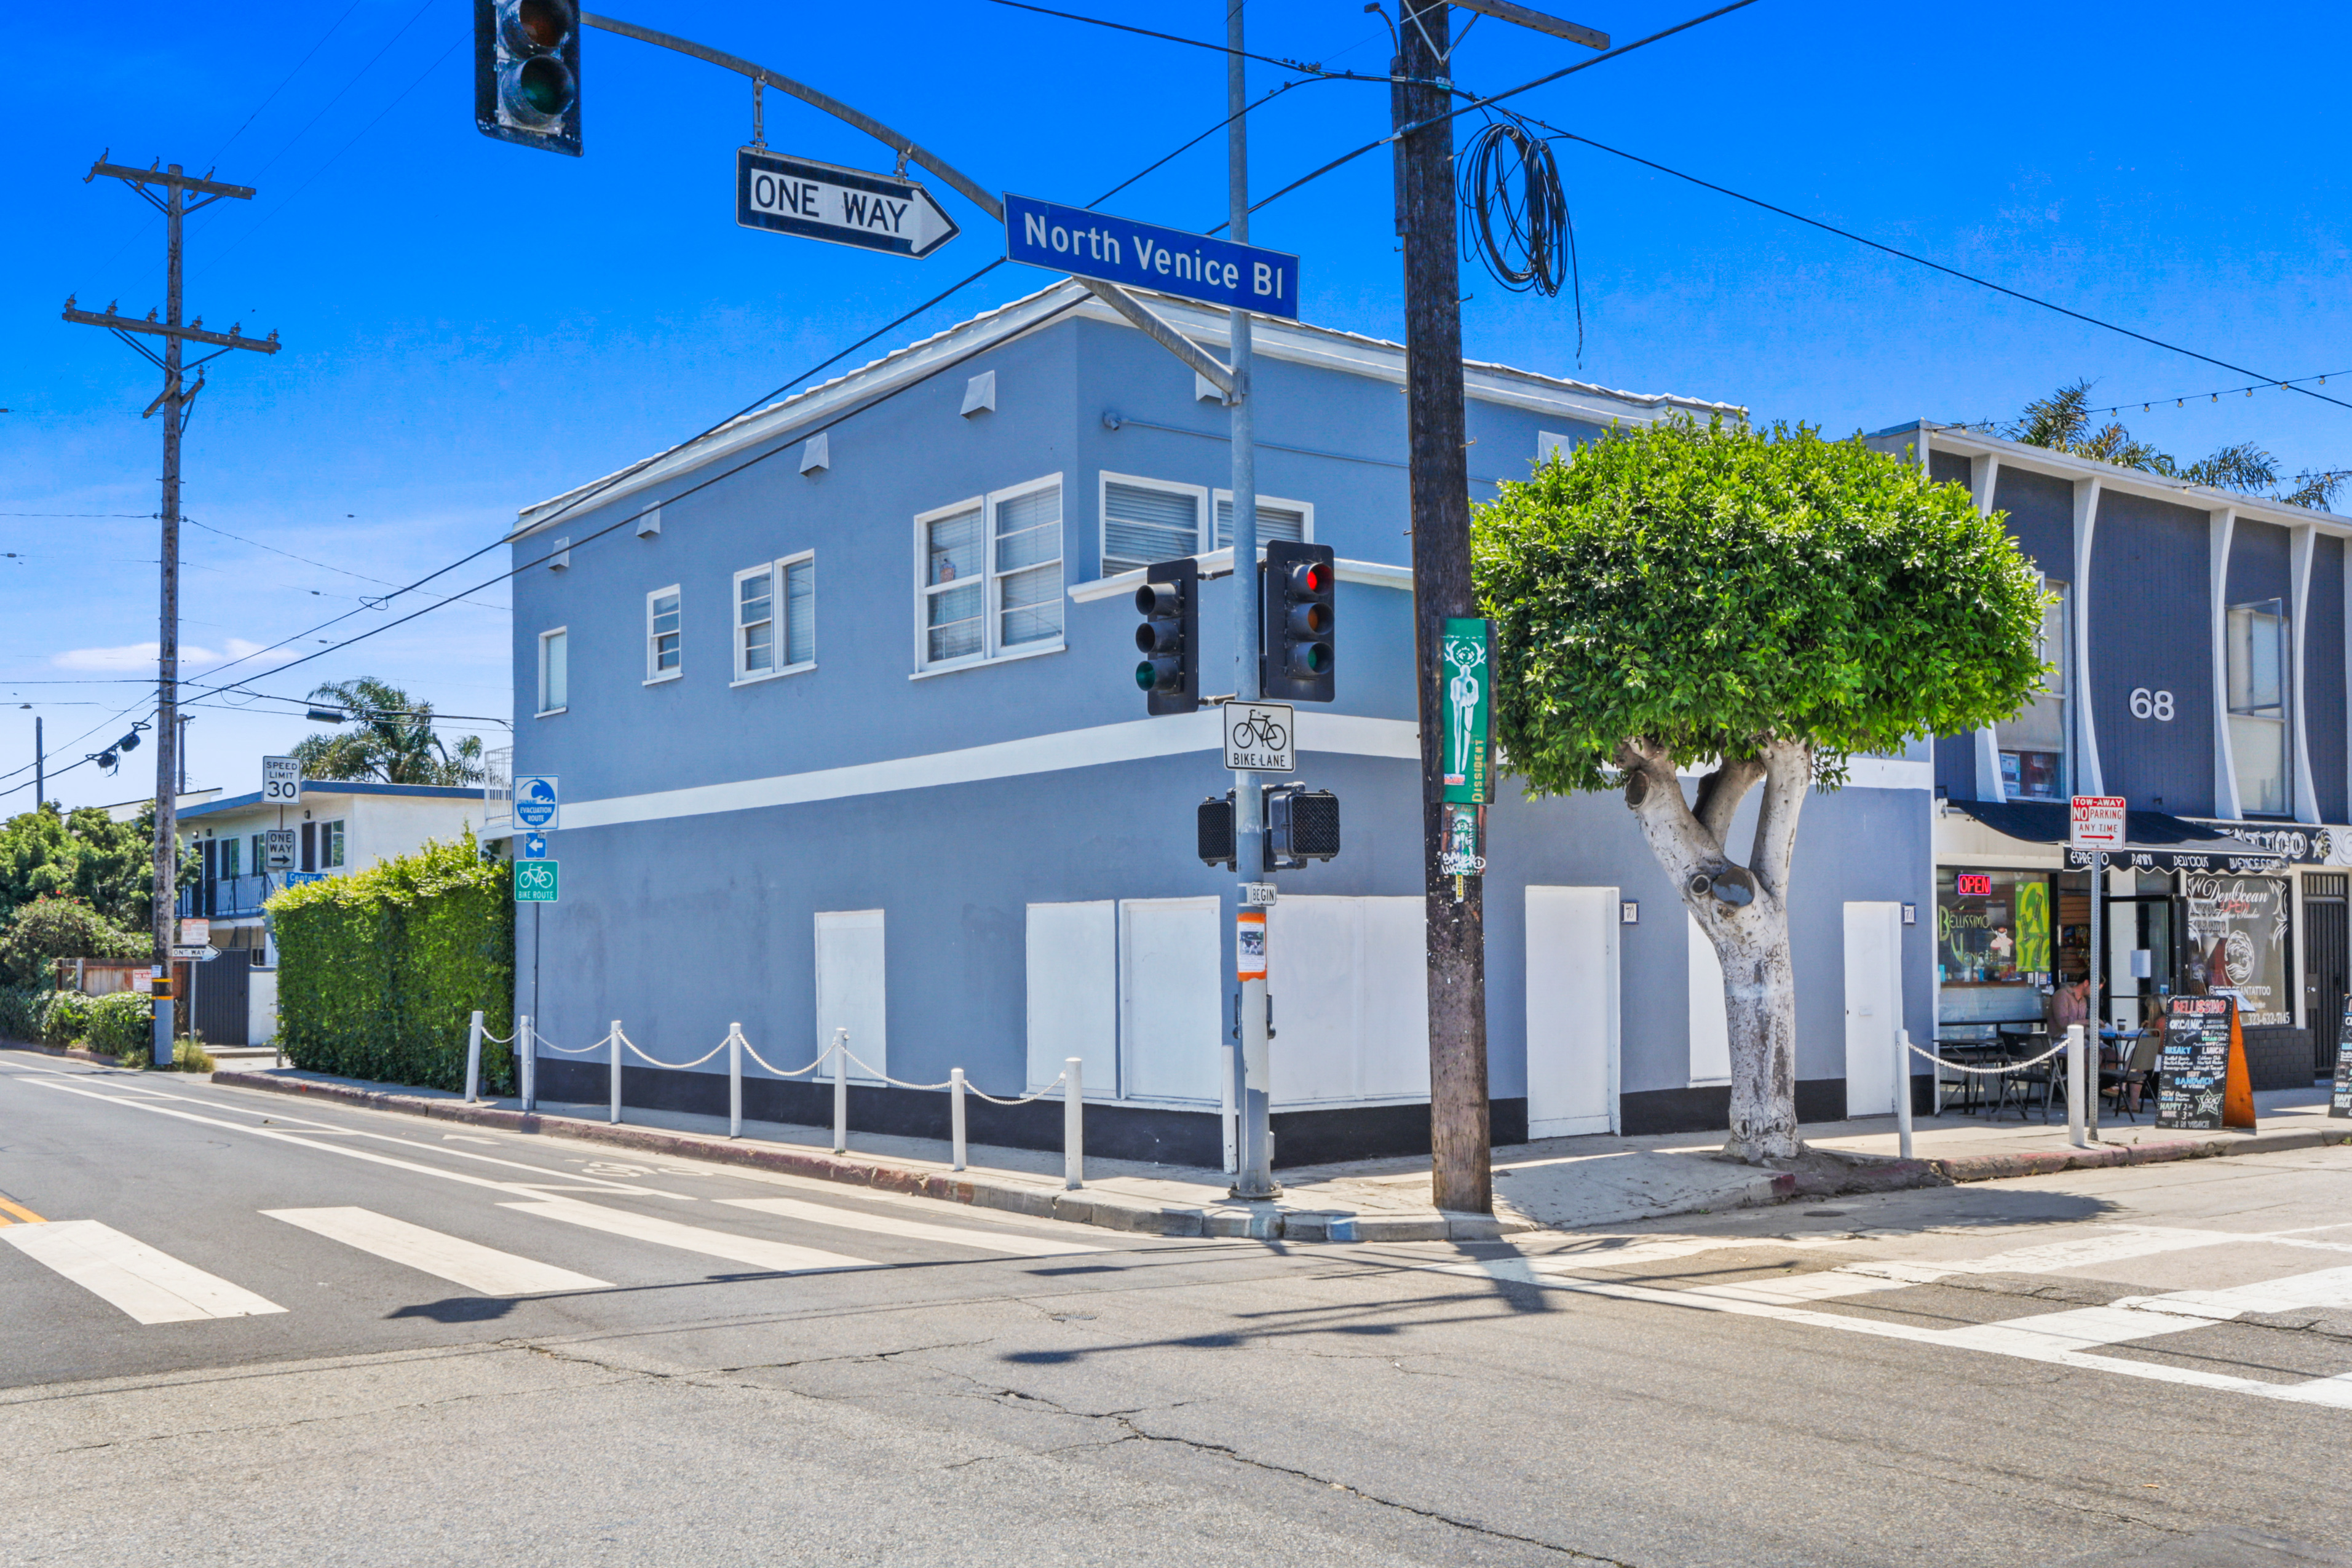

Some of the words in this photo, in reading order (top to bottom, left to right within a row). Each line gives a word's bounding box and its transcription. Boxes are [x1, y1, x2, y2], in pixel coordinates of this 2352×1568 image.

[755, 175, 820, 218] ONE
[844, 191, 908, 234] WAY
[1024, 213, 1121, 264] North
[1134, 237, 1239, 290] Venice
[2129, 687, 2174, 721] 68
[266, 761, 298, 770] SPEED
[1233, 753, 1256, 766] BIKE
[1261, 754, 1286, 767] LANE
[1471, 740, 1484, 802] DISSIDENT
[267, 781, 296, 798] 30
[2074, 798, 2122, 807] TOW-AWAY
[2073, 807, 2088, 821] NO
[2090, 809, 2122, 820] PARKING
[2078, 823, 2096, 832] ANY
[2099, 824, 2118, 833] TIME
[270, 833, 292, 843] ONE
[269, 844, 292, 853] WAY
[2070, 851, 2109, 865] ESPREO
[290, 873, 317, 882] Center
[1960, 876, 1990, 893] OPEN
[1252, 888, 1275, 902] BEGIN
[1626, 907, 1634, 919] 70
[1939, 905, 1990, 941] BELLISSIMO
[2173, 1000, 2227, 1014] BELLISSIMO
[2169, 1019, 2204, 1030] ORGANIC
[2164, 1046, 2192, 1055] BREAKY
